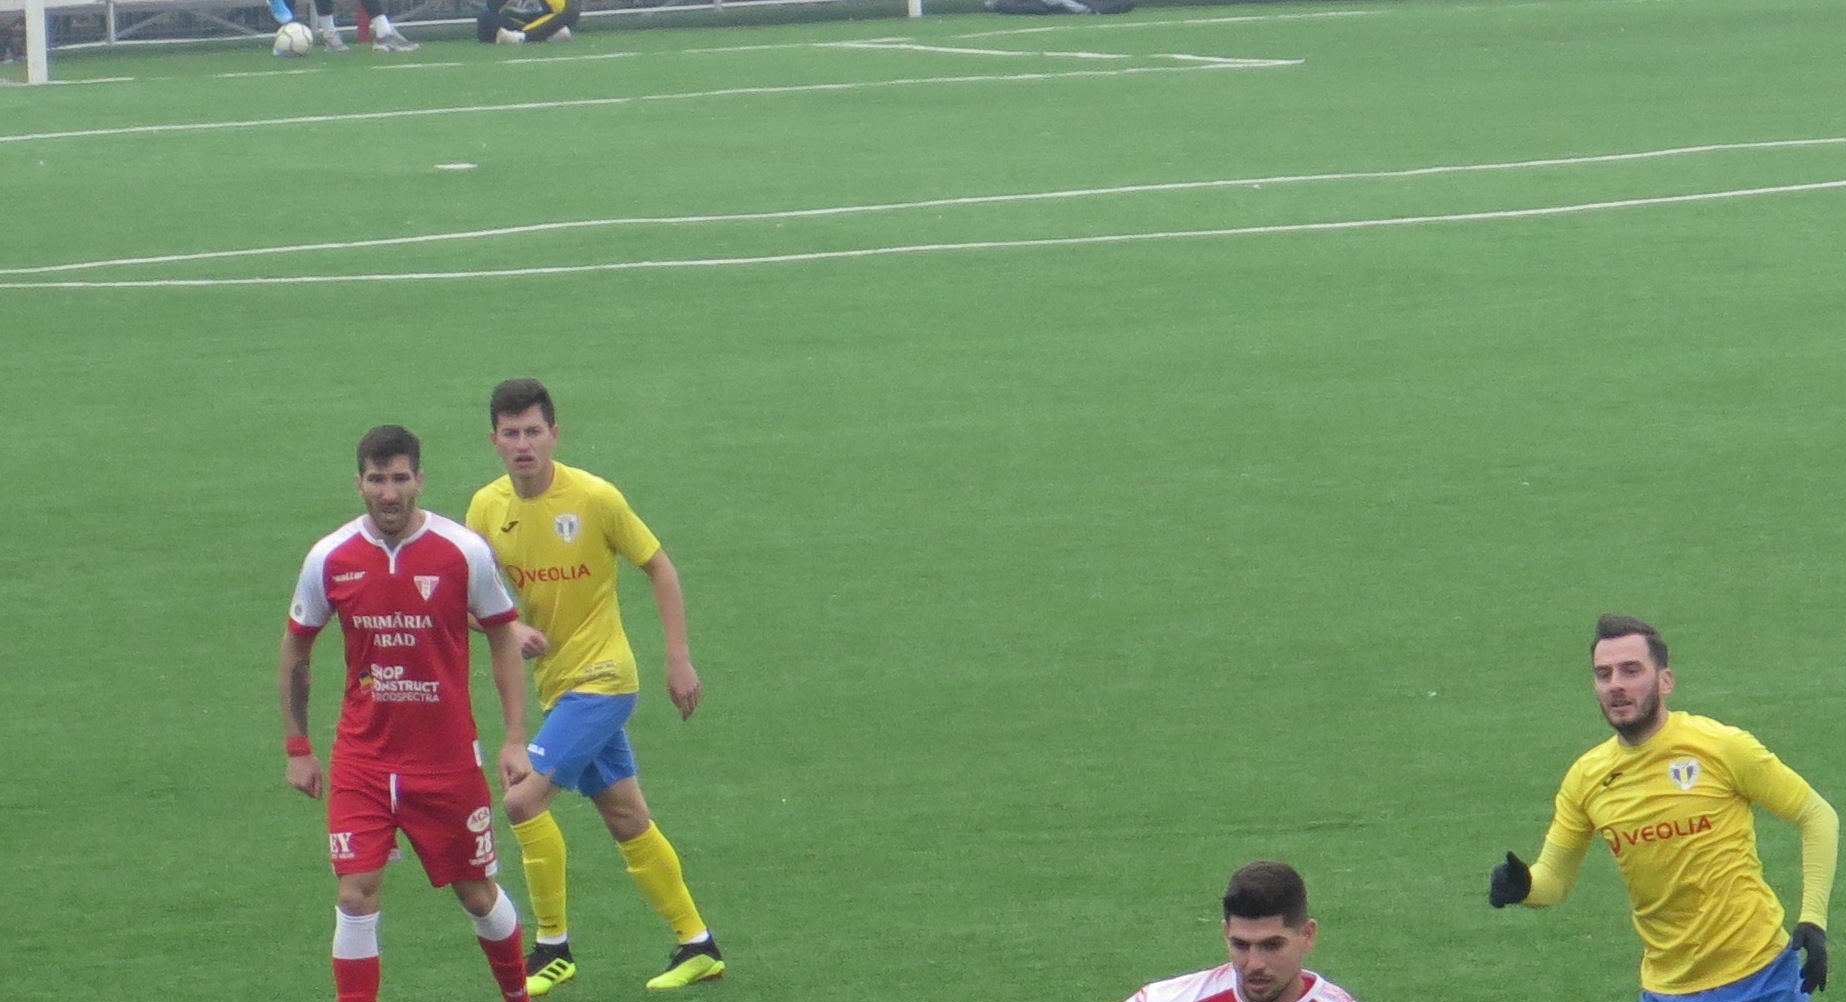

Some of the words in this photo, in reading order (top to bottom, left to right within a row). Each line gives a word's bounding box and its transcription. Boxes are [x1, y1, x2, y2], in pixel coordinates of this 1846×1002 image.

[523, 564, 592, 583] VEOLIA
[352, 611, 433, 629] PRIMĂRIA
[373, 633, 416, 648] ARAD
[373, 678, 440, 693] ONSTRUCT
[1622, 815, 1712, 846] VEOLIA
[475, 830, 492, 857] 28
